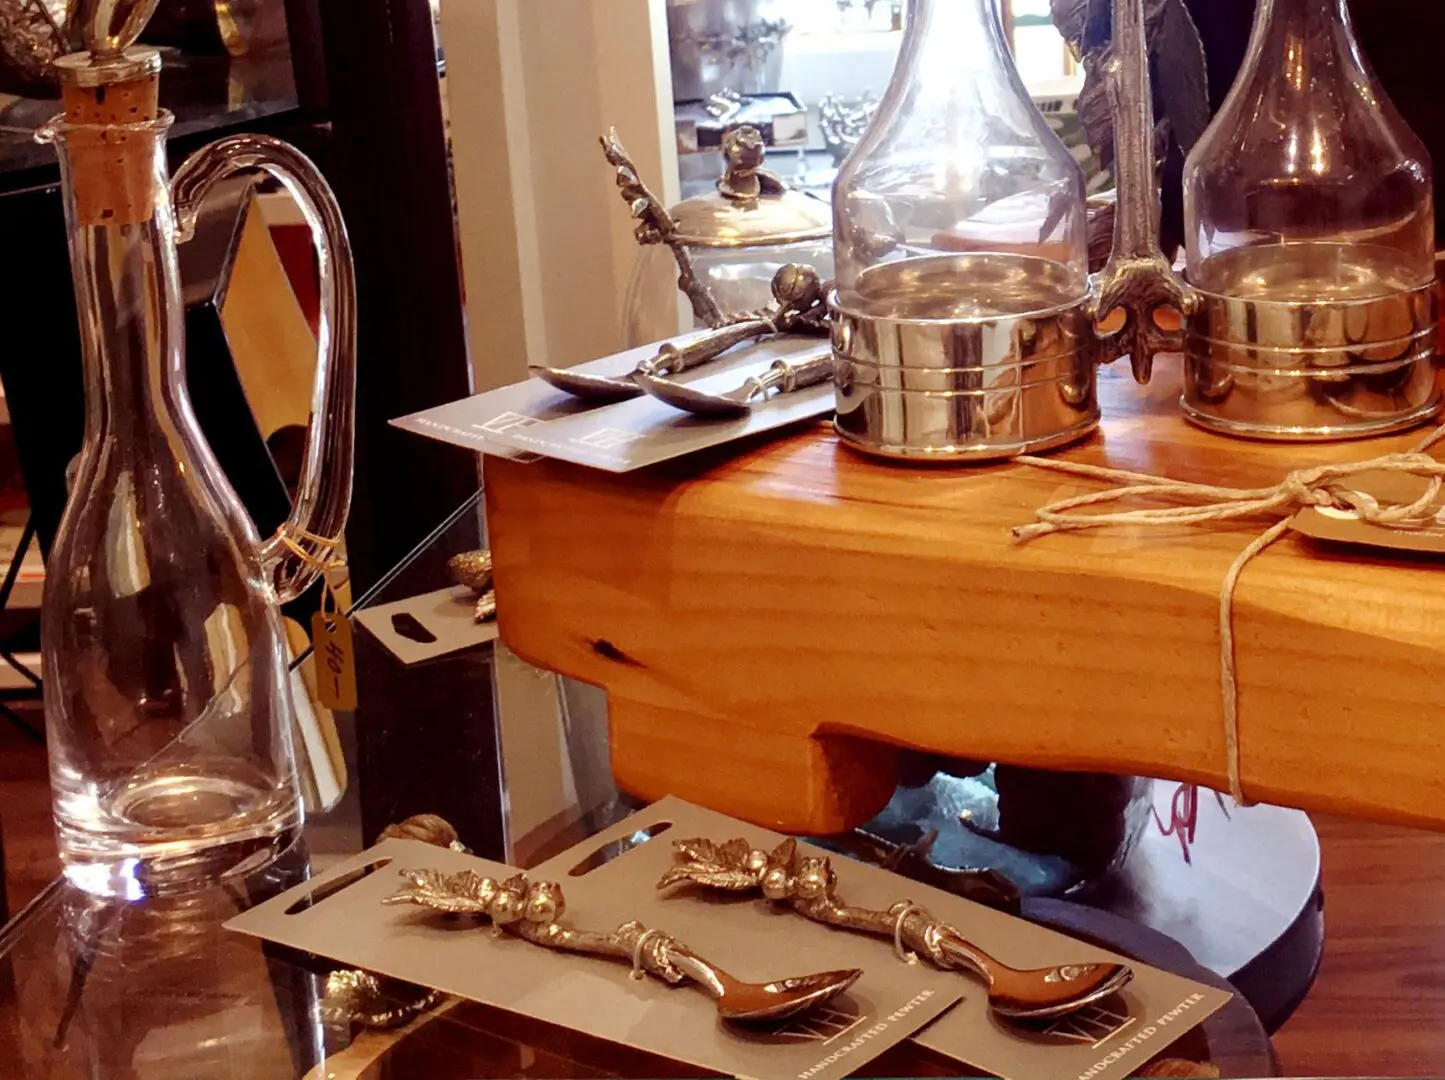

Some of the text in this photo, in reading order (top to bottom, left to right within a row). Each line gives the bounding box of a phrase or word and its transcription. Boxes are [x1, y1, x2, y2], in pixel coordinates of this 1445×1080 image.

[797, 988, 936, 1080] HANDCRAFTED PEWTER
[1078, 991, 1205, 1080] ANDCRAFTED PEWTER
